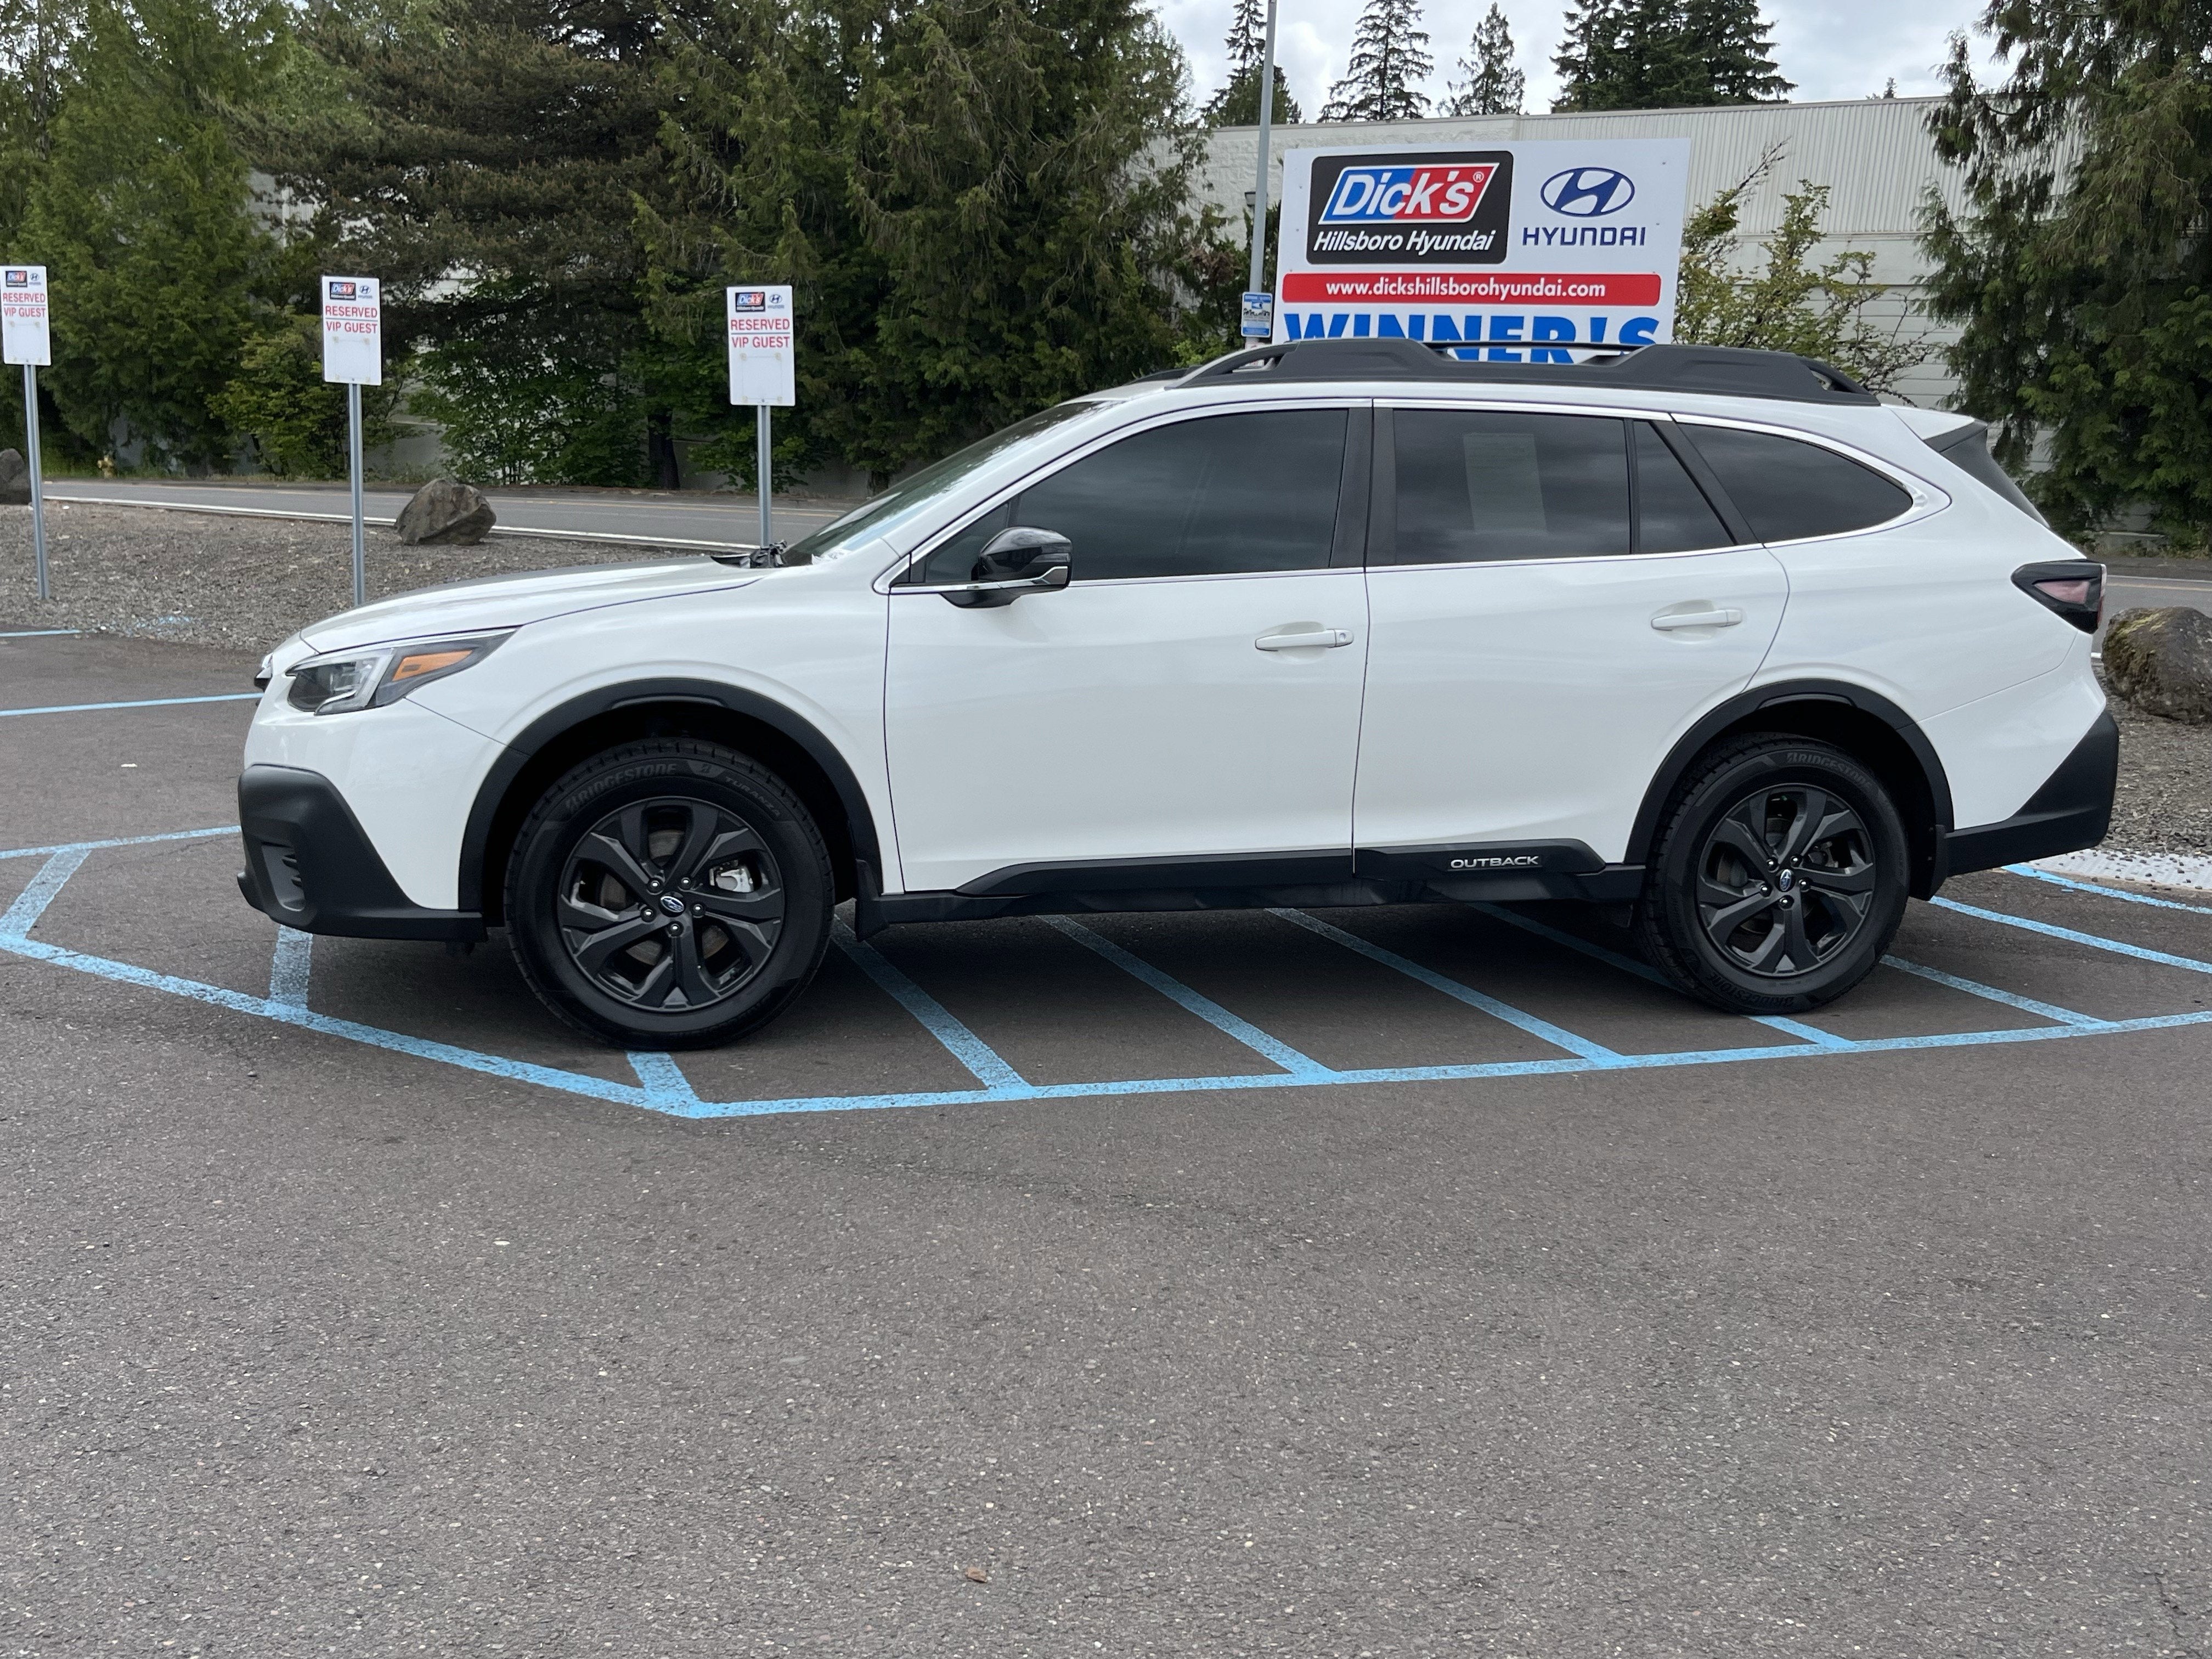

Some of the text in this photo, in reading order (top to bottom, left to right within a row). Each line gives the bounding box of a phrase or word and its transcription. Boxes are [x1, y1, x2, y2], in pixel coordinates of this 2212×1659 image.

[1313, 229, 1496, 256] Hillsboro Hyundai
[1522, 227, 1646, 246] HYUNDAI
[1326, 276, 1605, 301] www.dickshillsborohyundai.com
[3, 292, 46, 302] RESERVED
[4, 307, 46, 318] VIP GUEST
[325, 306, 377, 318] RESERVED
[326, 321, 377, 334] VIP GUEST
[731, 319, 790, 330] RESERVED
[732, 336, 790, 348] VIP GUEST
[1451, 856, 1539, 868] OUTBACK
